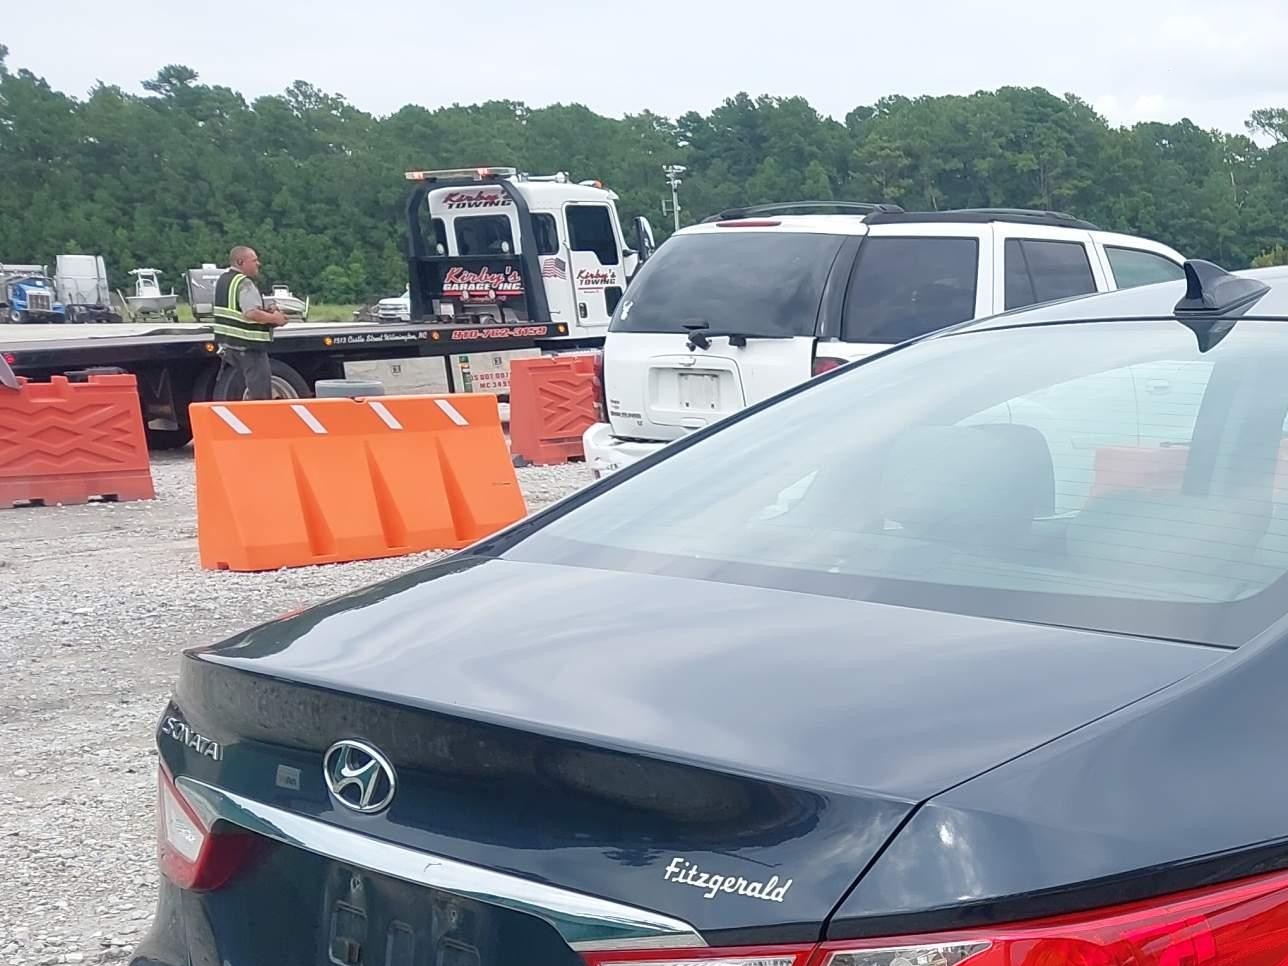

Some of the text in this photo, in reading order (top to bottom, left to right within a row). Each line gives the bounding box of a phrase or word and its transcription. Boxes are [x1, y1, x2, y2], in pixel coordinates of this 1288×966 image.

[448, 200, 512, 209] TOWING
[444, 266, 521, 288] Kirby's
[576, 269, 616, 280] Kirby's
[443, 282, 525, 290] GARAGE INC.
[162, 717, 222, 761] SONATA
[663, 857, 793, 902] Fitzgerald
